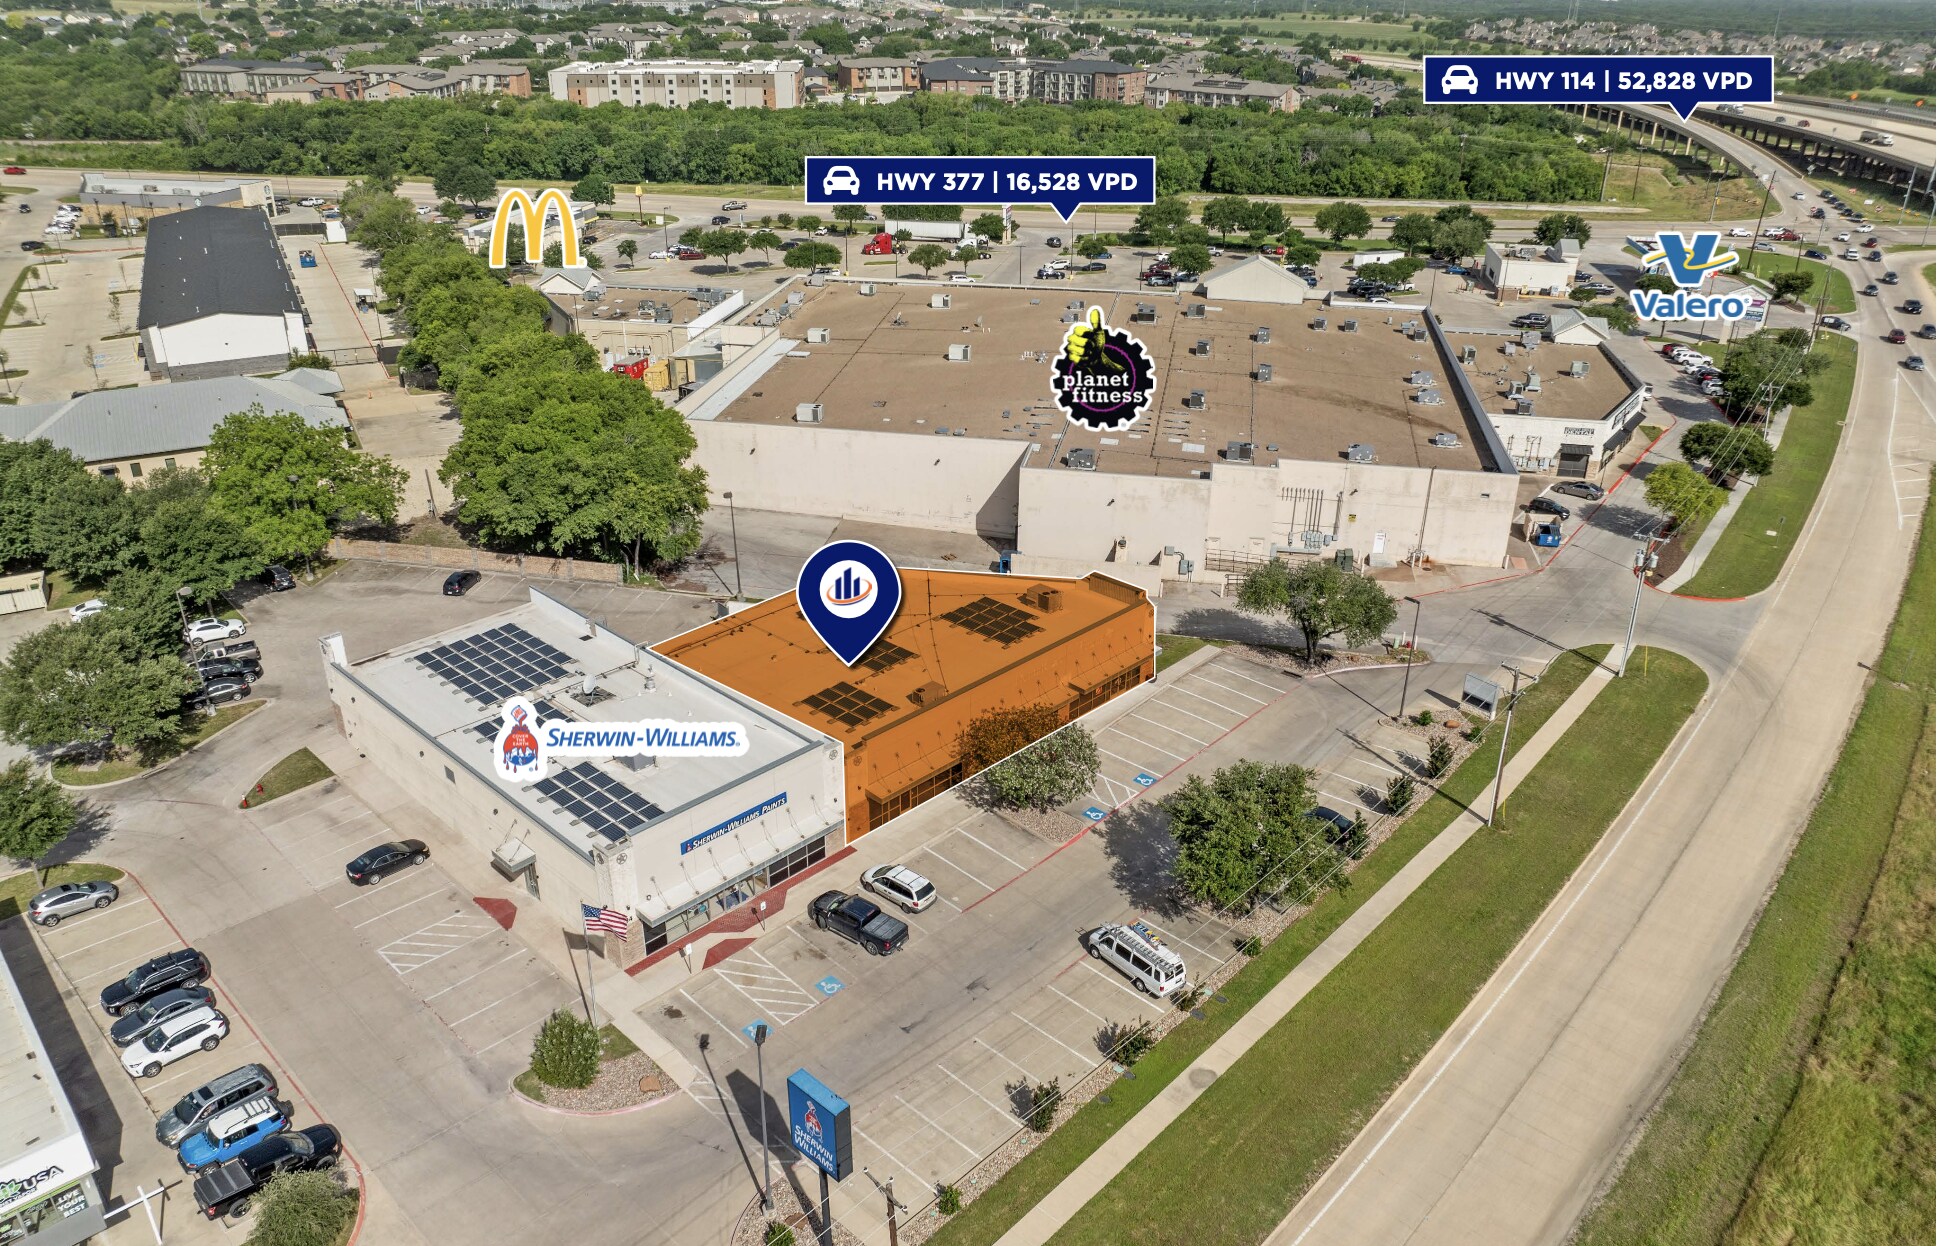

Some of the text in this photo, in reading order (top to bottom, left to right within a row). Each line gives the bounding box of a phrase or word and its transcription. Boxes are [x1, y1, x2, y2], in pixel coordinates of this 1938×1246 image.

[692, 797, 786, 850] SHERWIN-WILLIAMS PAINTS
[794, 1124, 833, 1162] SHERWIN
[794, 1133, 834, 1172] WILLIAMS
[21, 1166, 64, 1191] USA
[57, 1188, 80, 1205] LIVE
[57, 1195, 86, 1212] YOUR
[63, 1203, 86, 1218] BEST
